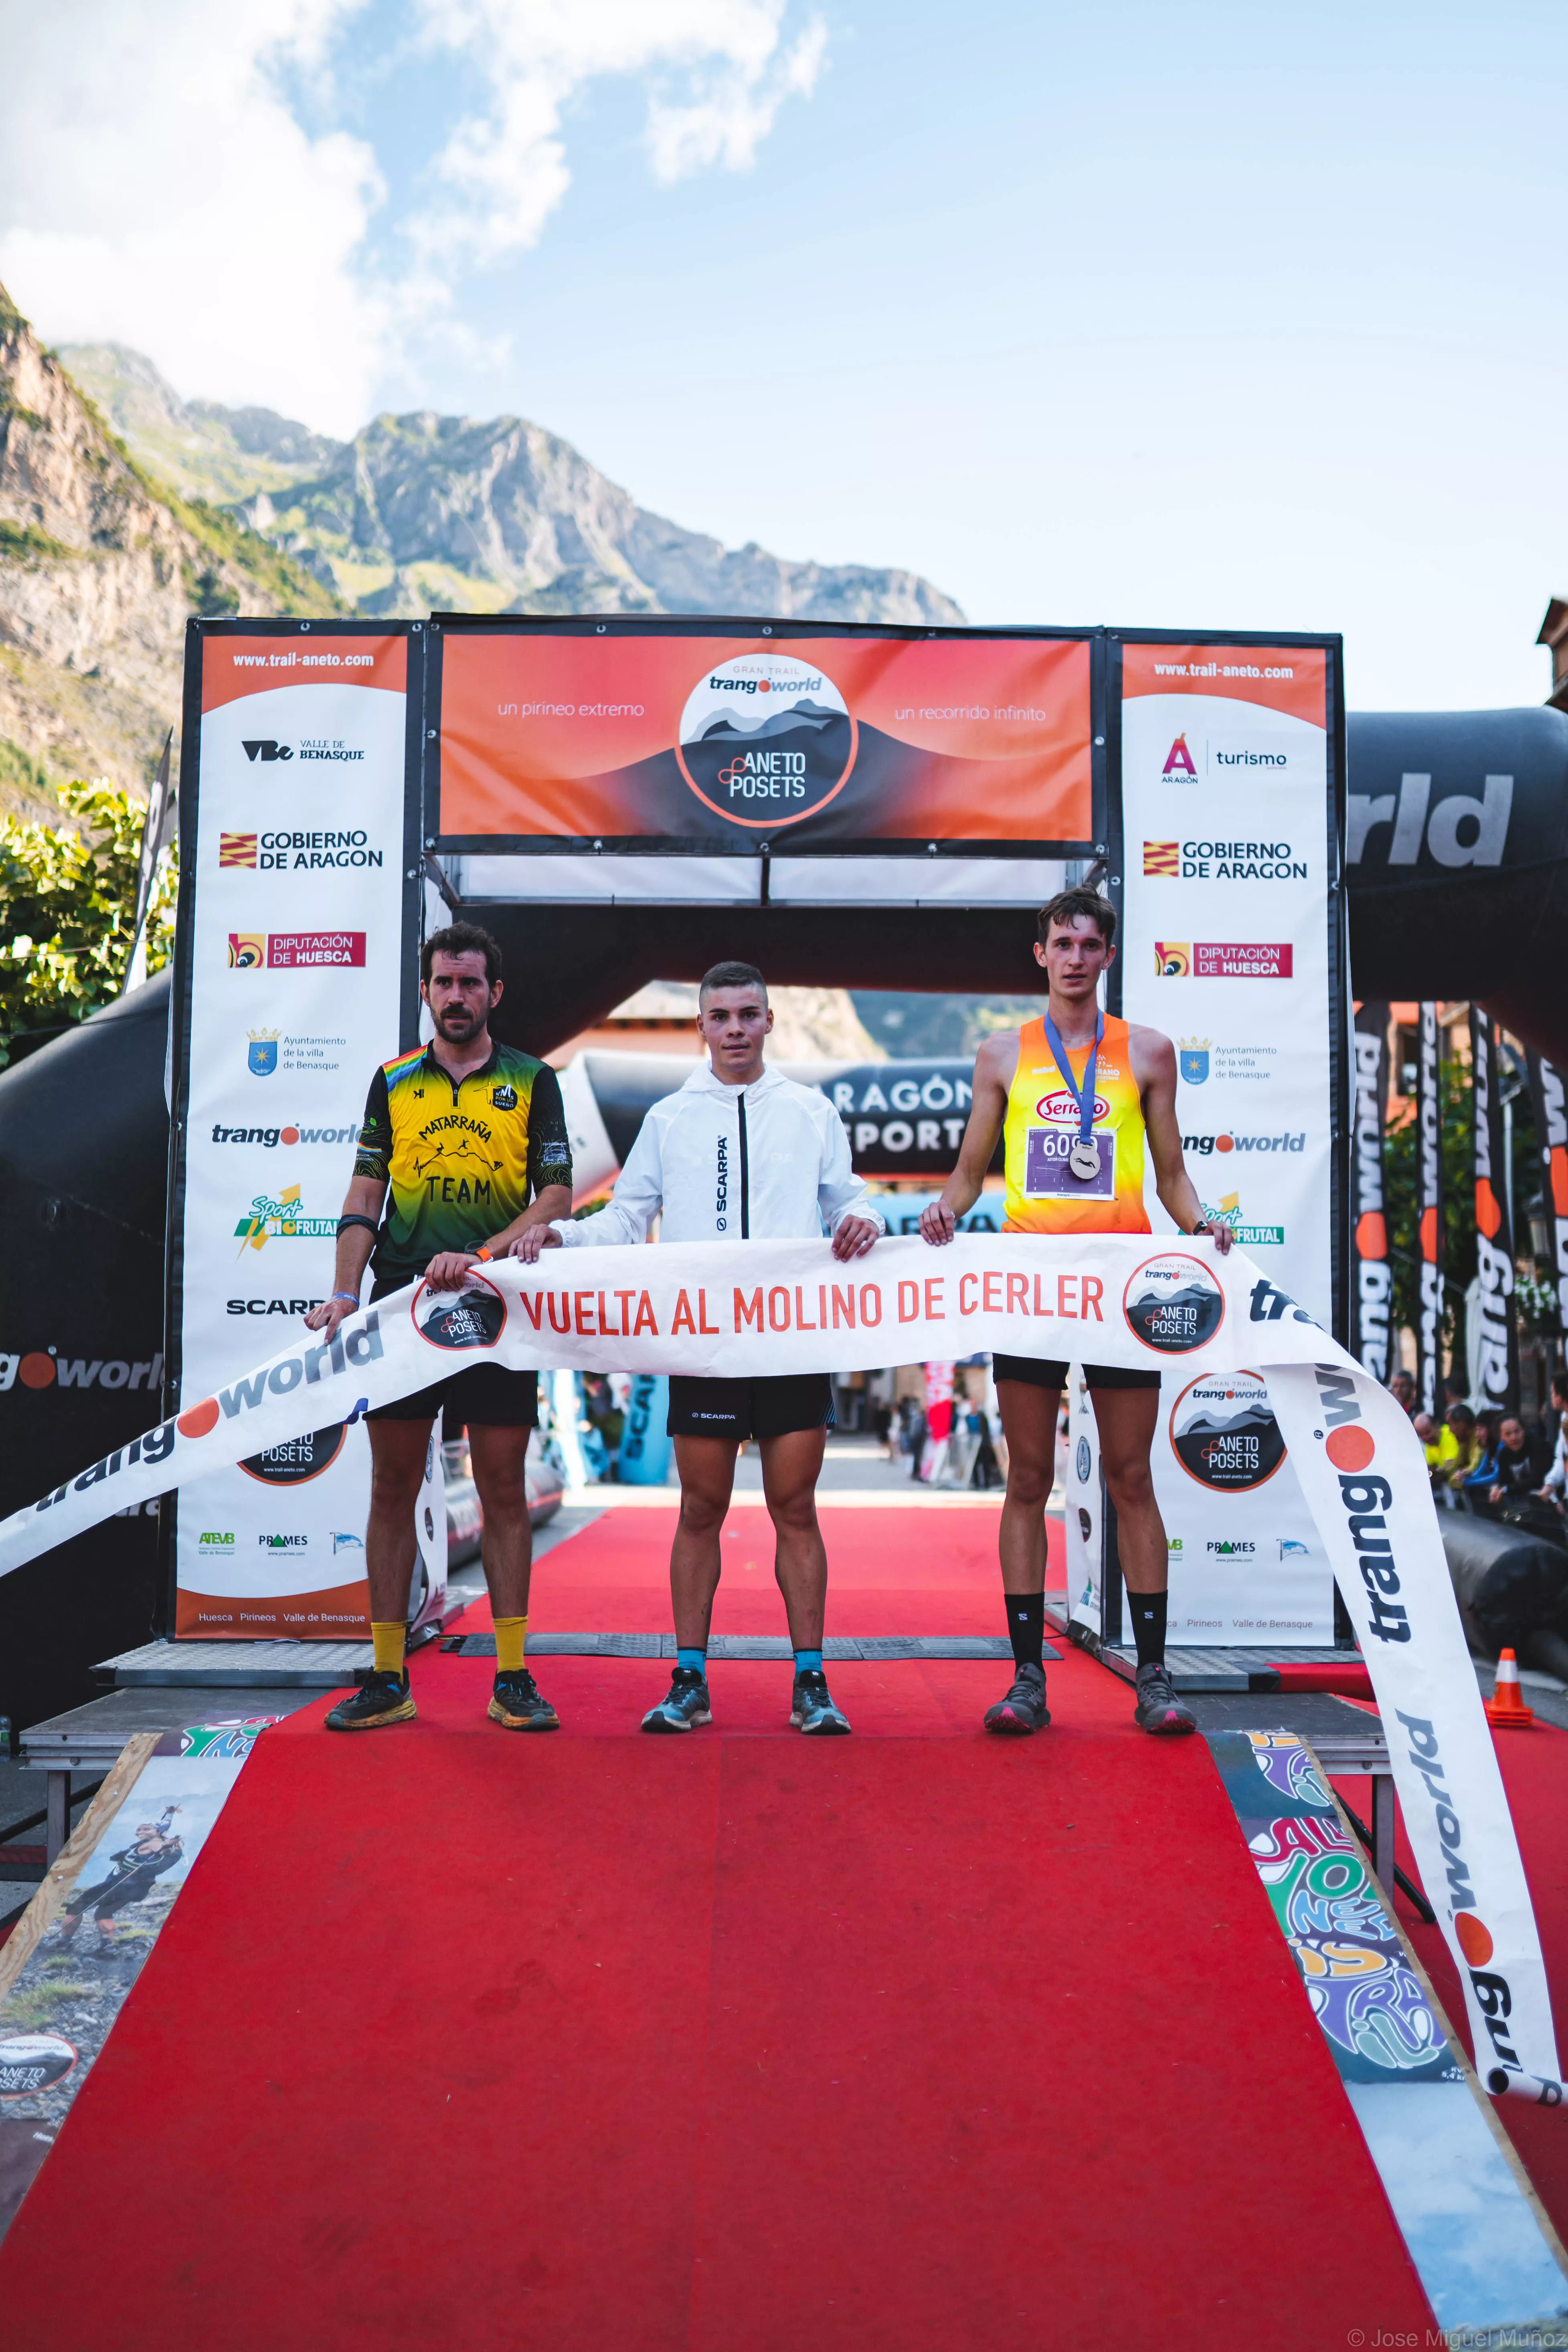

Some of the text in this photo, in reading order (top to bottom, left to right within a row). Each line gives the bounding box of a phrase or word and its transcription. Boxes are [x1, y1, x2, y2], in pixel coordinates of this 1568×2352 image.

[233, 652, 374, 667] www.trail-aneto.com
[733, 665, 800, 675] GRAN TRAIL
[1154, 663, 1294, 679] www.trail-aneto.com
[710, 675, 822, 694] trangoworld
[498, 700, 645, 719] un pirineo extremo
[894, 704, 1047, 722] un recorrido infinito
[300, 740, 345, 748] VALLE DE
[299, 750, 364, 762] BENASQUE
[745, 752, 806, 775] ANETO
[1216, 750, 1287, 766] turismo
[730, 776, 805, 798] POSETS
[1162, 775, 1198, 785] ARAGÓN
[261, 830, 367, 849] GOBIERNO
[1182, 842, 1291, 859] GOBIERNO
[260, 851, 383, 869] DE ARAGON
[1182, 862, 1307, 879] DE ARAGON
[274, 934, 353, 950] DIPUTACIÓN
[274, 951, 352, 964] DE HUESCA
[1199, 946, 1280, 960] DIPUTACIÓN
[1199, 962, 1280, 975] DE HUESCA
[284, 1037, 346, 1046] Ayuntamiento
[284, 1049, 324, 1057] de la villa
[1216, 1046, 1277, 1056] Ayuntamiento
[283, 1061, 339, 1071] de Benasque
[1216, 1058, 1256, 1067] de la villa
[1216, 1070, 1271, 1081] de Benasque
[1044, 1100, 1103, 1115] Serrao
[418, 1115, 492, 1143] MATARRAÑA
[1181, 1133, 1306, 1155] ngoworld
[716, 1137, 728, 1212] SCARPA
[426, 1176, 491, 1205] TEAM
[249, 1196, 303, 1223] Sport
[1233, 1228, 1280, 1243] FRUTAL
[227, 1300, 326, 1315] SCARP
[520, 1271, 1104, 1336] VUELTA AL MOLINO DE CERLER
[452, 1309, 482, 1323] ANETO
[1161, 1306, 1197, 1321] ANETO
[449, 1321, 487, 1337] POSETS
[1152, 1320, 1197, 1335] POSETS
[1193, 1389, 1268, 1400] trangoworld
[1219, 1436, 1259, 1452] ANETO
[261, 1446, 313, 1462] POSETS
[1209, 1453, 1259, 1469] POSETS
[199, 1533, 235, 1544] ATEVB
[259, 1534, 308, 1547] PRAMES
[1207, 1540, 1256, 1554] PRAMES
[199, 1613, 233, 1622] Huesca
[240, 1613, 276, 1622] Pirineos
[283, 1613, 365, 1624] Valle de Benasque
[1187, 1619, 1223, 1628] Pirineos
[1233, 1620, 1313, 1630] Valle de Benasque
[0, 2067, 47, 2078] ANETO
